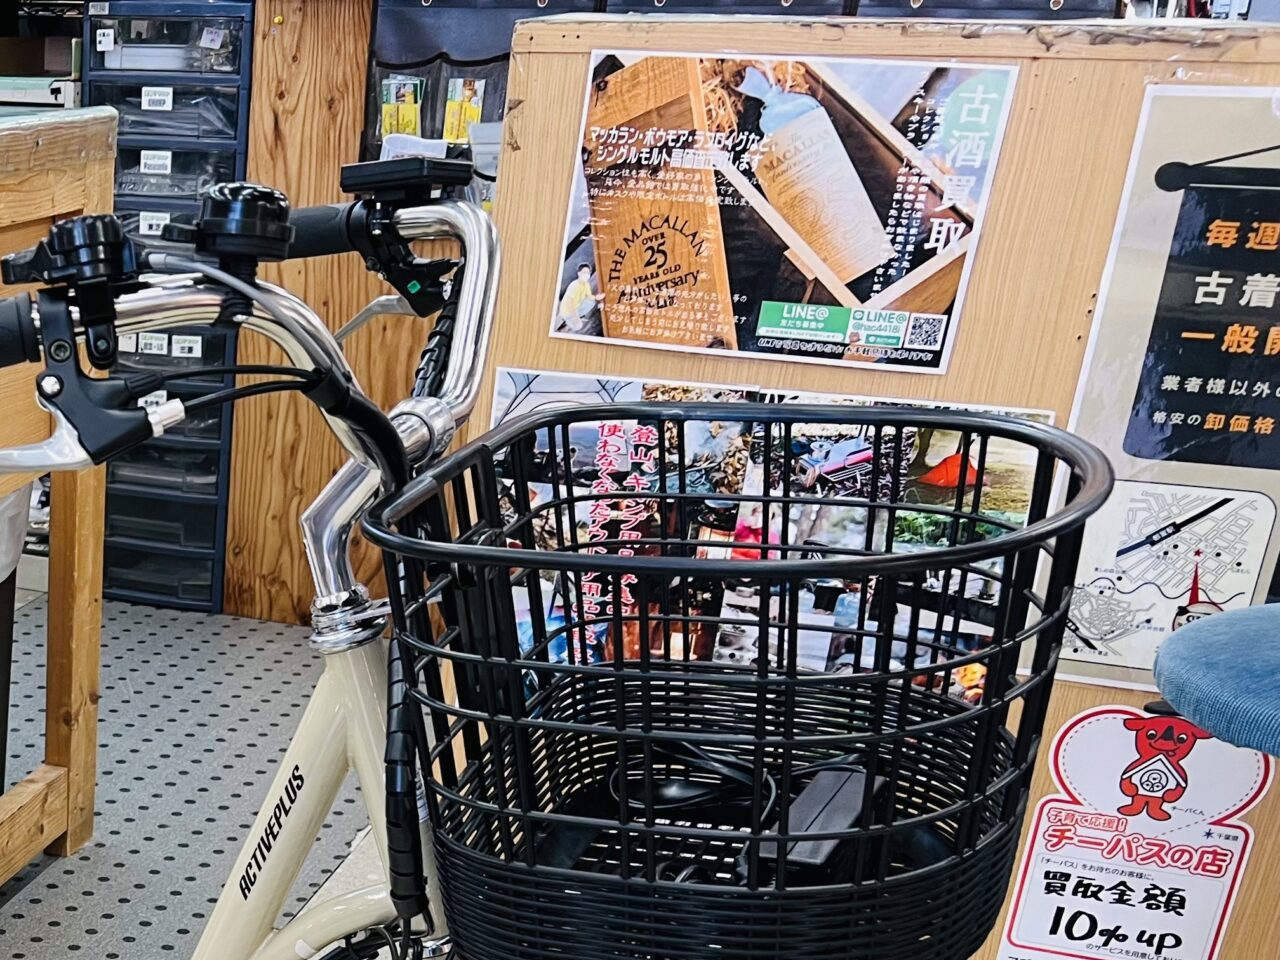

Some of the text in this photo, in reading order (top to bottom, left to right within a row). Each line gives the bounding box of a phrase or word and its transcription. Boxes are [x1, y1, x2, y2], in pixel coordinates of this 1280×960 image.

[924, 84, 999, 255] 古酒買取
[608, 247, 627, 283] THE
[623, 214, 707, 257] MACALLAN
[641, 232, 666, 246] OVER
[1206, 219, 1280, 251] 毎週
[643, 240, 668, 270] 25
[662, 264, 682, 276] OLD
[1194, 271, 1280, 308] 古着
[783, 304, 830, 321] LINE@
[866, 312, 908, 324] LINE@
[1152, 410, 1275, 435] 格安の卸価格
[239, 764, 305, 901] ACTIVEPLUS
[1217, 832, 1239, 842] 千葉県
[1044, 825, 1233, 878] チーパスの店
[1043, 870, 1187, 917] 買取金額
[1049, 905, 1184, 956] 10% up
